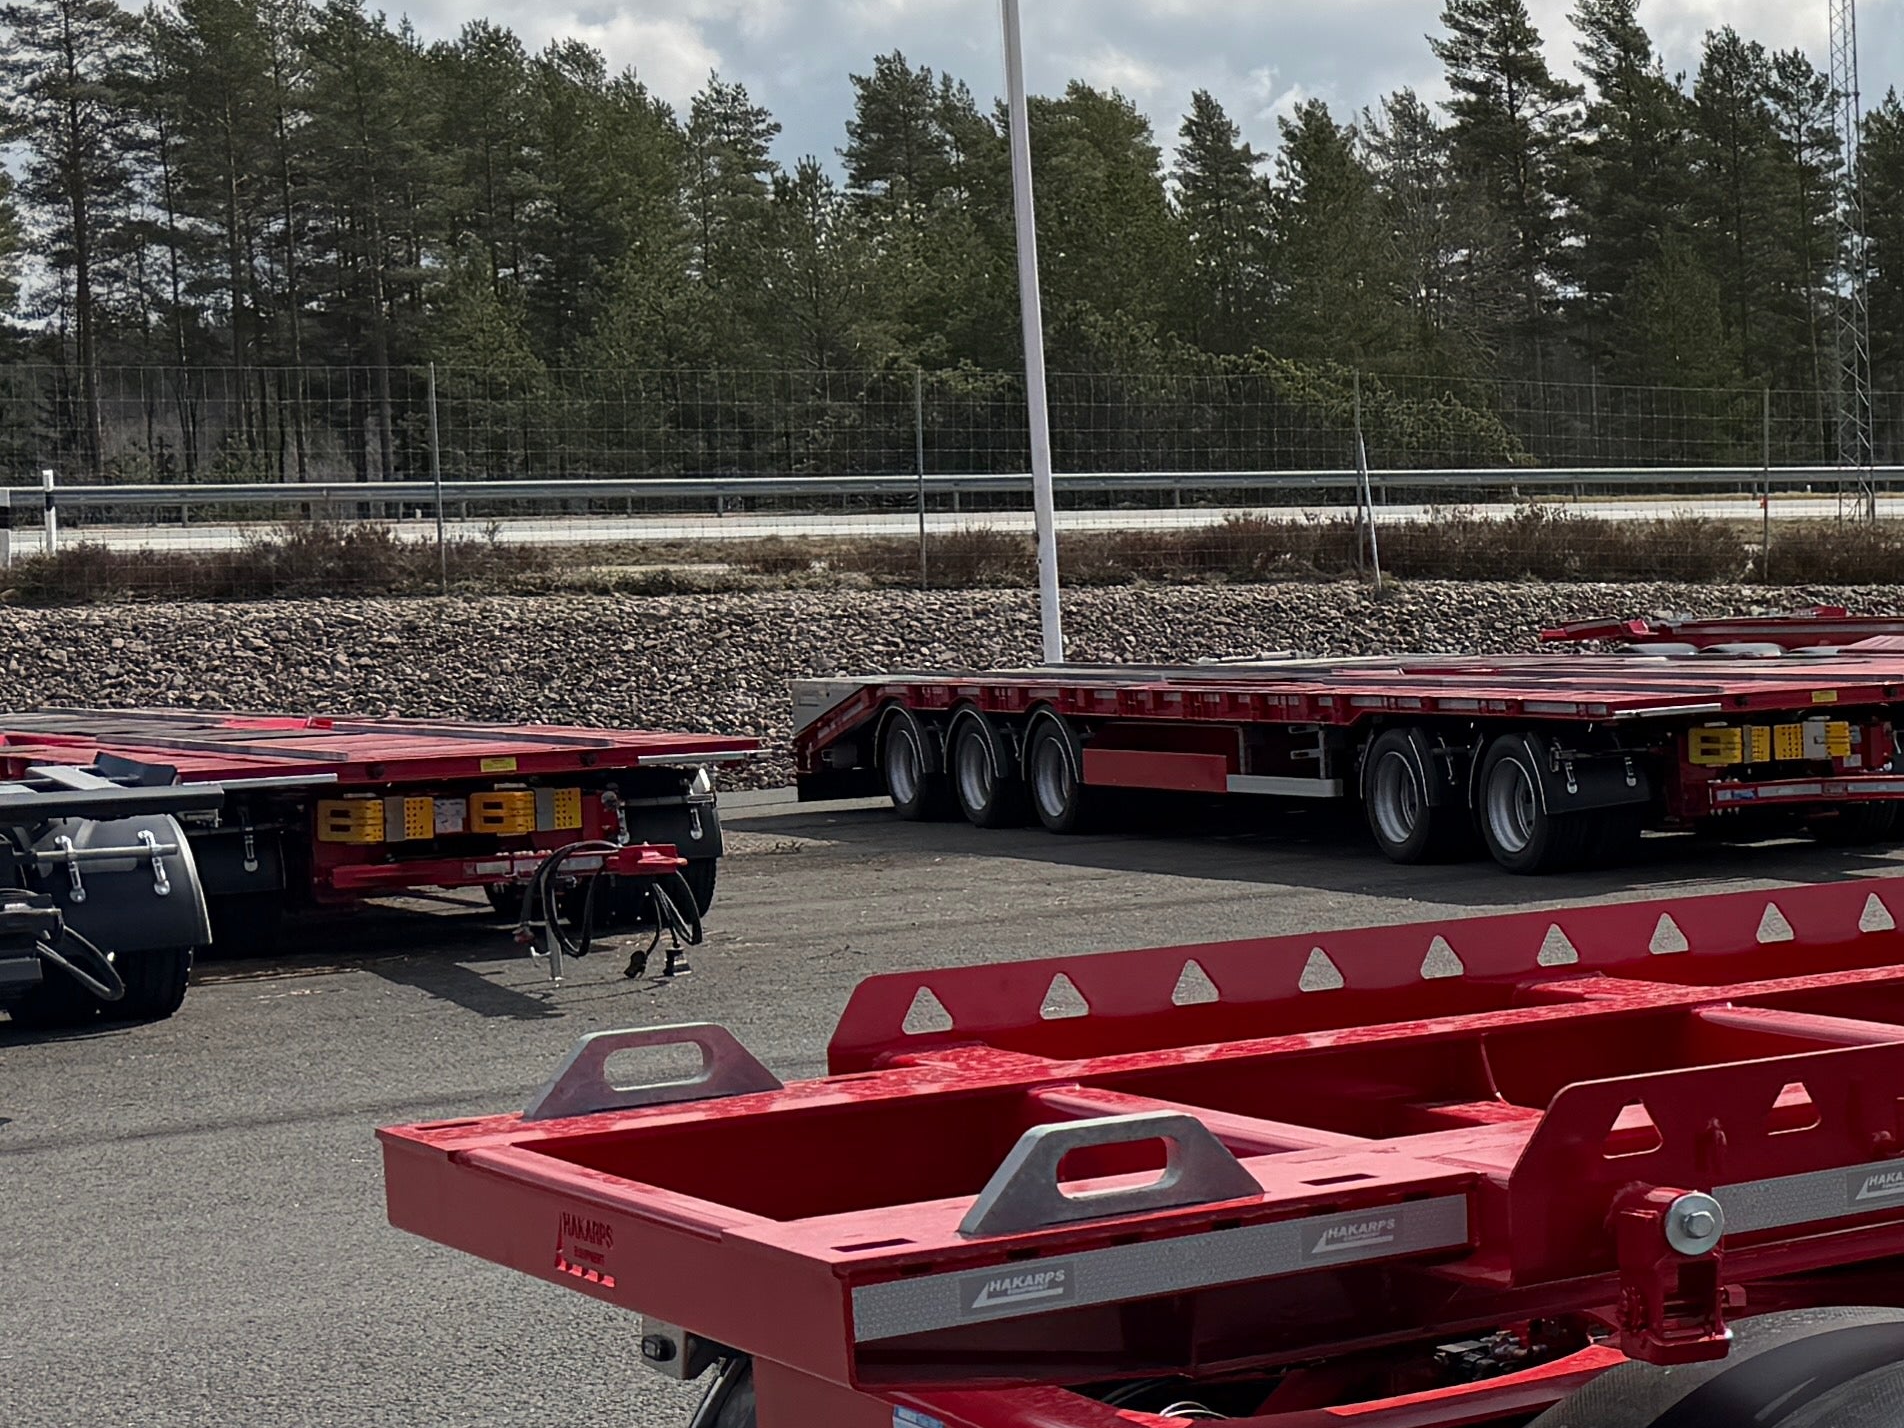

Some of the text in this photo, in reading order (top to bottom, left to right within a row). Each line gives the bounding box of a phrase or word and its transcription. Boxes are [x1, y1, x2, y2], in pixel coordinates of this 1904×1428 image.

[562, 1210, 614, 1249] HAKARPS
[1328, 1218, 1396, 1239] HAKARPS
[989, 1269, 1065, 1292] HAKARPS
